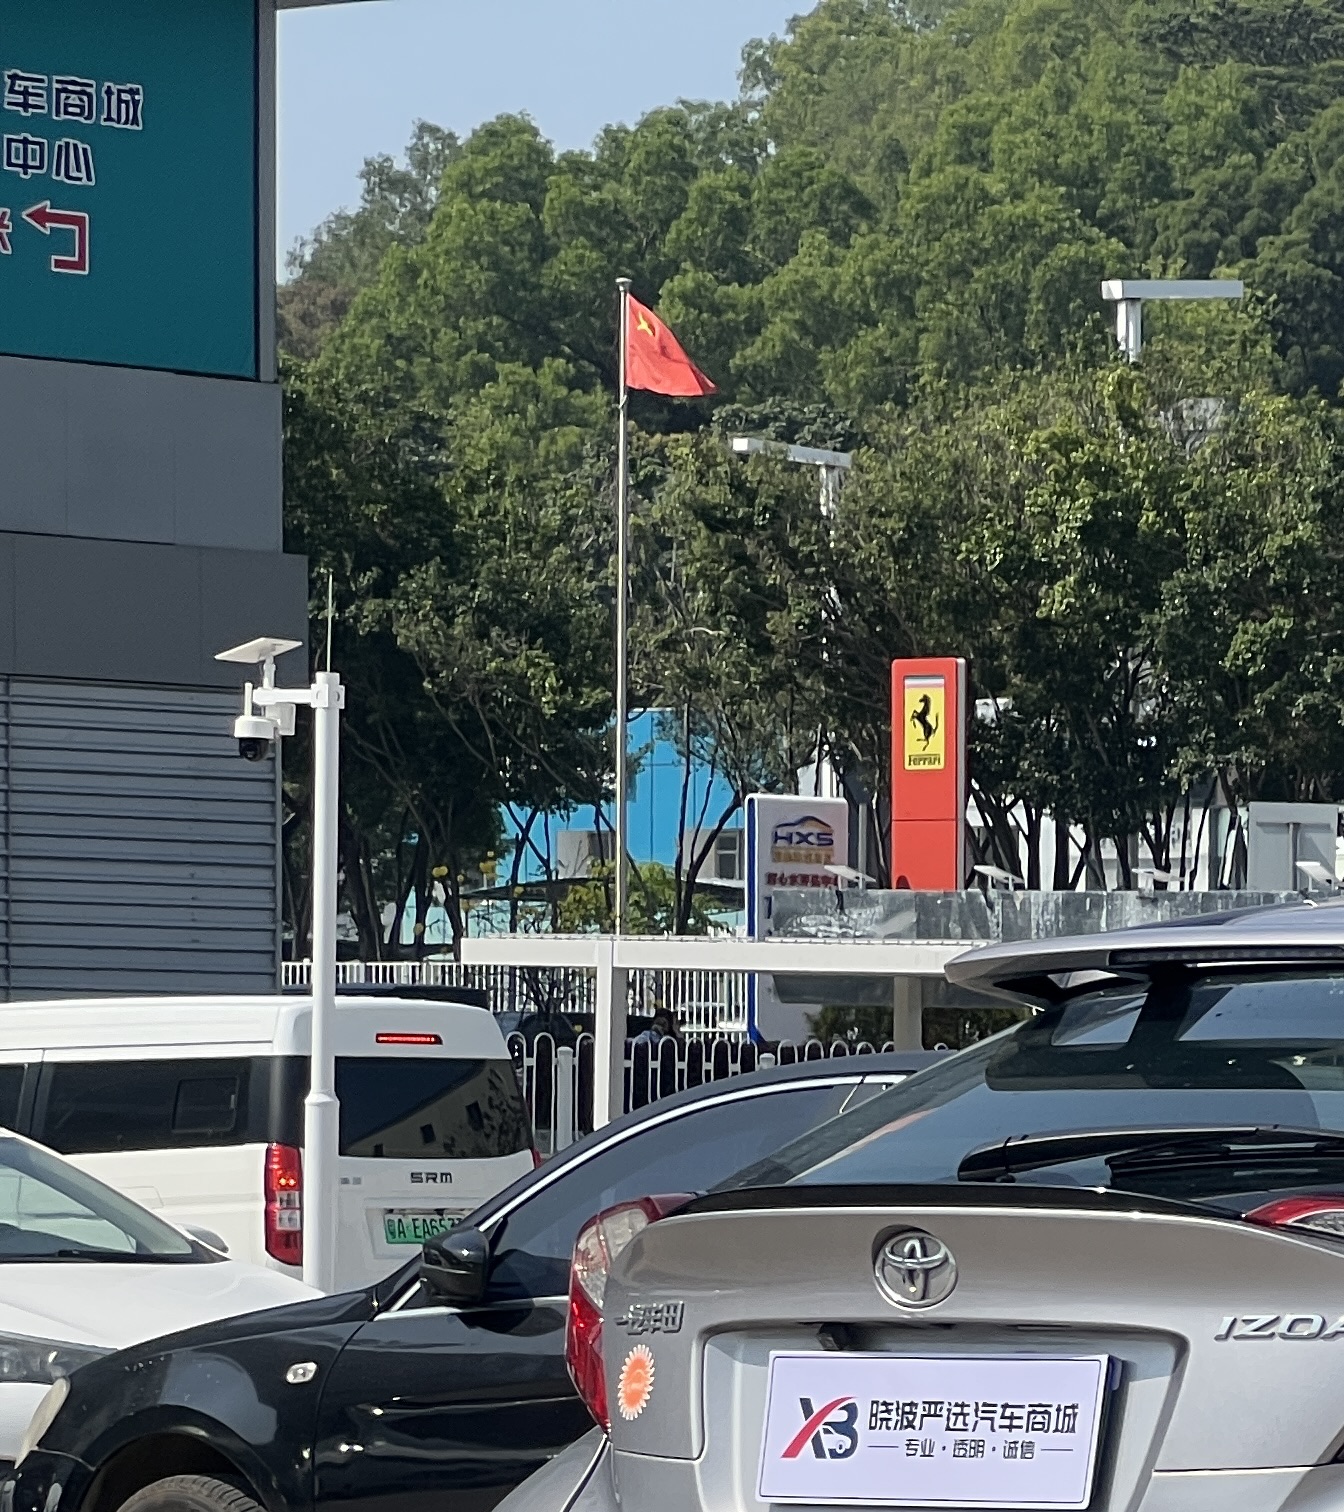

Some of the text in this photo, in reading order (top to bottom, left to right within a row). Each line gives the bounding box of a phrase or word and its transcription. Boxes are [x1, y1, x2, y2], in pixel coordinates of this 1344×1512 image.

[3, 69, 143, 130] 车商城
[3, 132, 95, 186] 中心
[908, 754, 941, 766] Ferrari
[410, 1172, 453, 1184] SRM
[868, 1400, 1079, 1435] 晓波严选汽车商城
